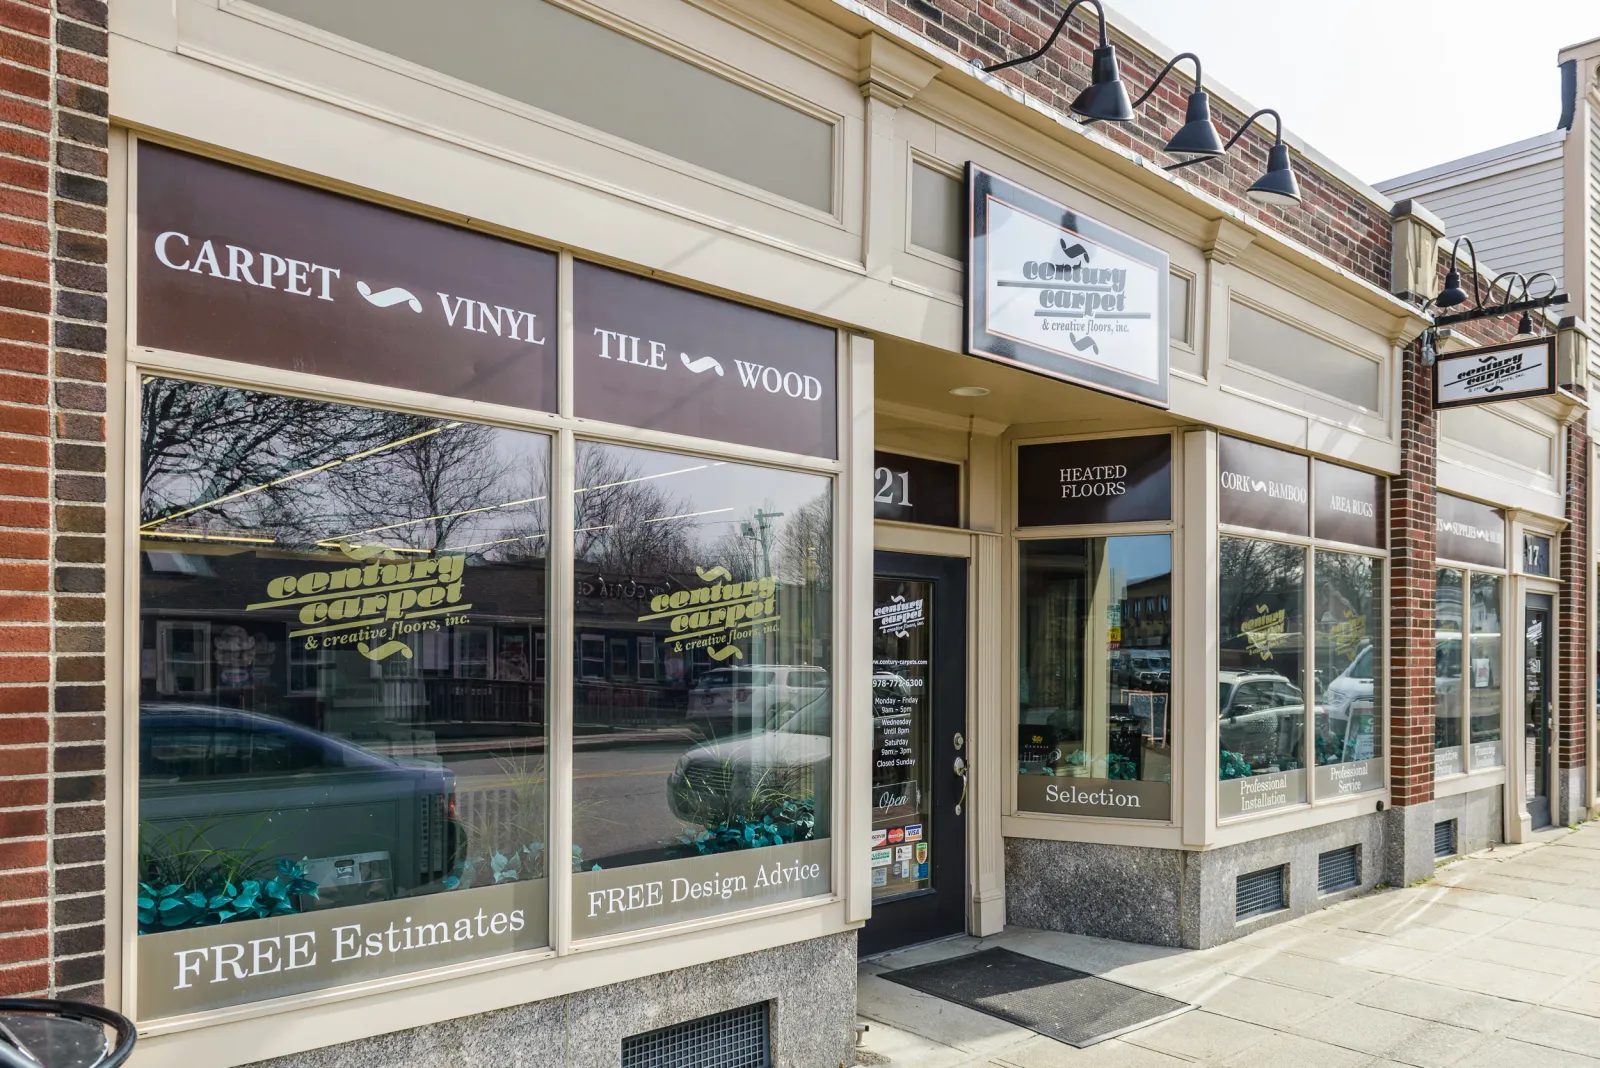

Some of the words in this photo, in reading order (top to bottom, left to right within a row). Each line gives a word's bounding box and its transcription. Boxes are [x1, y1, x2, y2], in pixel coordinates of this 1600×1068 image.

[1022, 260, 1127, 292] century
[154, 231, 340, 301] CARPET
[436, 292, 546, 345] VINYL
[1039, 289, 1126, 316] carpet
[1041, 318, 1050, 330] &
[1051, 319, 1085, 332] creative
[1085, 319, 1114, 335] floors,
[1115, 320, 1130, 333] inc.
[593, 327, 667, 371] TILE
[733, 359, 822, 401] WOOD
[1457, 353, 1523, 379] century
[1467, 363, 1522, 385] carpet
[1059, 464, 1127, 482] HEATED
[874, 467, 913, 507] 21
[1061, 481, 1126, 498] FLOORS
[1221, 471, 1250, 493] CORK
[1268, 480, 1307, 504] BAMBOO
[1329, 495, 1351, 513] AREA
[1352, 499, 1373, 517] RUGS
[1528, 544, 1540, 566] 17
[266, 553, 466, 599] century
[299, 577, 465, 625] carpet
[650, 576, 776, 613] century
[670, 598, 775, 633] carpet
[874, 598, 923, 616] century
[881, 608, 922, 625] carpet
[304, 635, 319, 650] &
[322, 626, 387, 648] creative
[387, 617, 441, 641] floors,
[445, 613, 470, 627] inc.
[673, 641, 683, 653] &
[685, 634, 727, 651] creative
[763, 622, 780, 634] inc.
[875, 697, 896, 706] Monday
[902, 696, 919, 704] Friday
[899, 705, 912, 713] 5pm
[881, 718, 912, 726] Wednesday
[883, 727, 896, 735] Until
[897, 727, 910, 735] 8pm
[881, 748, 894, 756] 9am
[899, 747, 912, 755] 3pm
[884, 738, 909, 746] Saturday
[876, 759, 895, 768] Closed
[895, 758, 916, 766] Sunday
[1330, 762, 1369, 781] Professional
[1240, 774, 1287, 795] Professional
[1338, 779, 1361, 793] Service
[879, 790, 908, 814] Open
[1045, 784, 1141, 808] Selection
[1241, 792, 1286, 811] Installation
[587, 880, 663, 918] FREE
[670, 872, 748, 904] Design
[753, 859, 820, 888] Advice
[173, 931, 317, 991] FREE
[331, 907, 525, 963] Estimates
